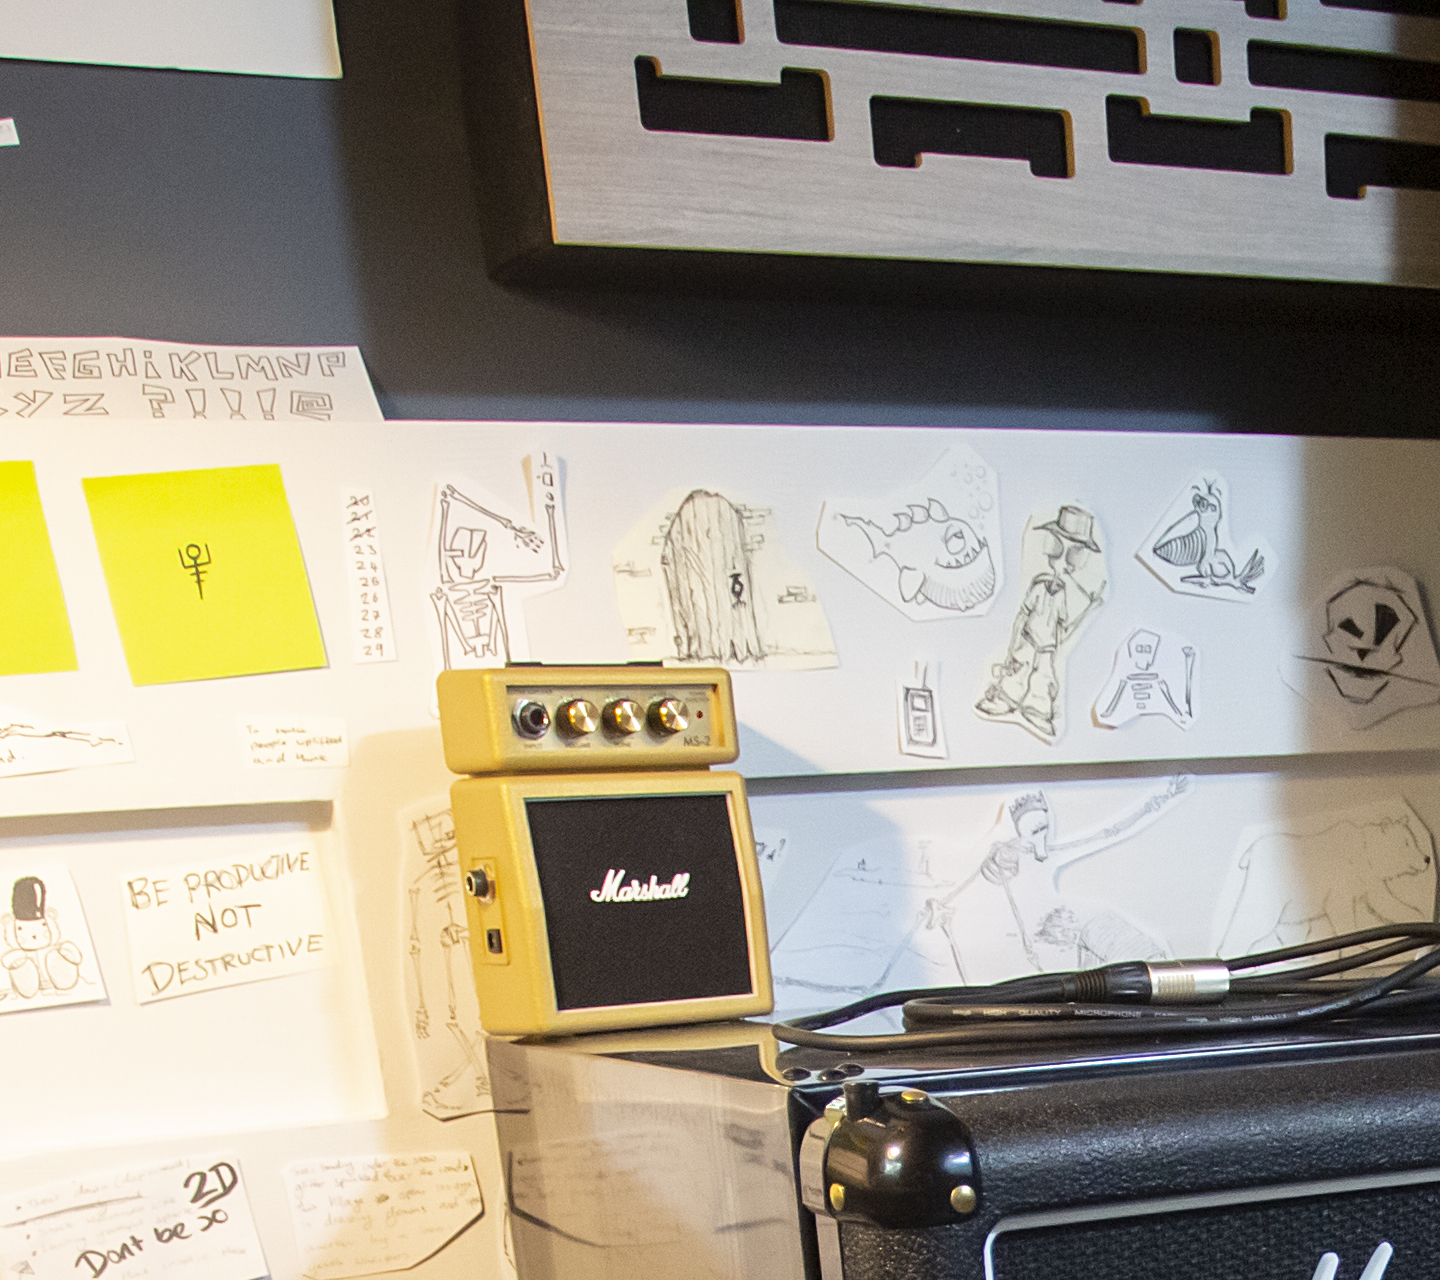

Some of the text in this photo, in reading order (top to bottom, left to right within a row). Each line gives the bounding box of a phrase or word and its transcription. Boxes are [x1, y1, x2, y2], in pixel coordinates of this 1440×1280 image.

[360, 626, 383, 638] 28
[363, 643, 384, 657] 29
[127, 851, 311, 909] BE PRODUCTIVE
[590, 869, 690, 902] Marshall
[193, 904, 262, 941] NOT
[141, 934, 324, 996] DESTRUCTIVE
[183, 1161, 239, 1208] 2D
[74, 1235, 143, 1279] Dont
[154, 1222, 192, 1244] be
